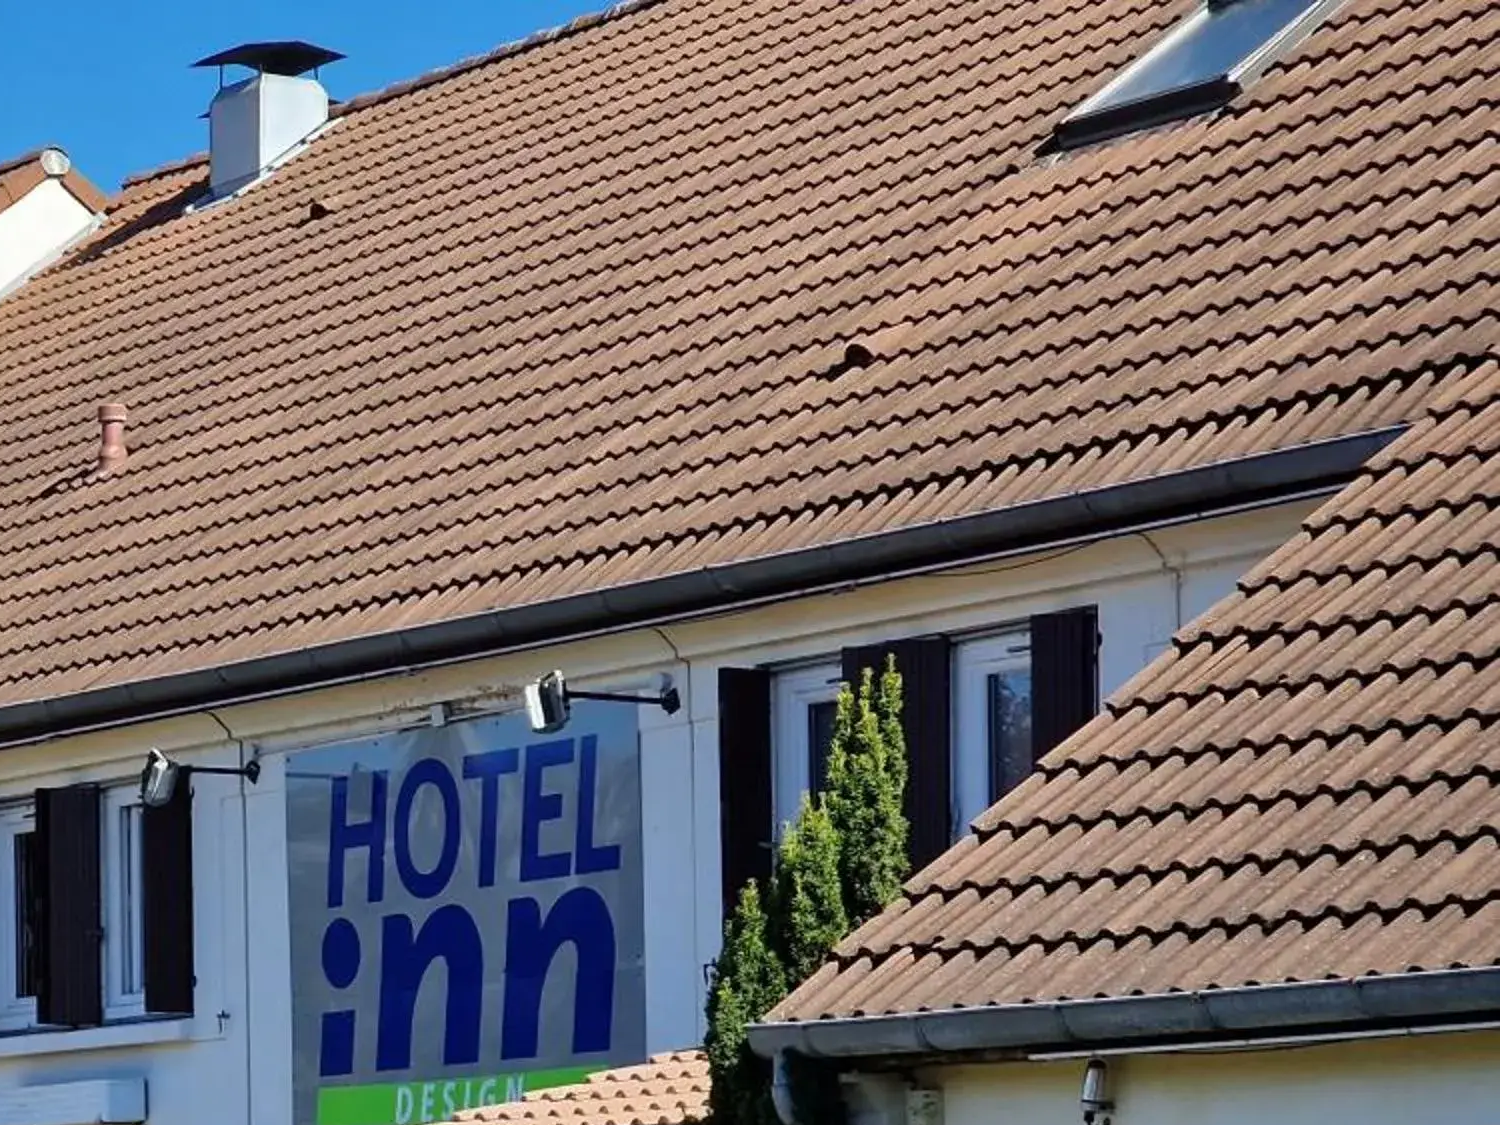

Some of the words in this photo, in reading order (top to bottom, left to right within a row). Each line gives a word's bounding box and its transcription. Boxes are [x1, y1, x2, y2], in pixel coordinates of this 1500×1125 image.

[327, 734, 620, 908] HOTEL
[320, 886, 616, 1077] inn
[396, 1072, 525, 1125] DESIGN
